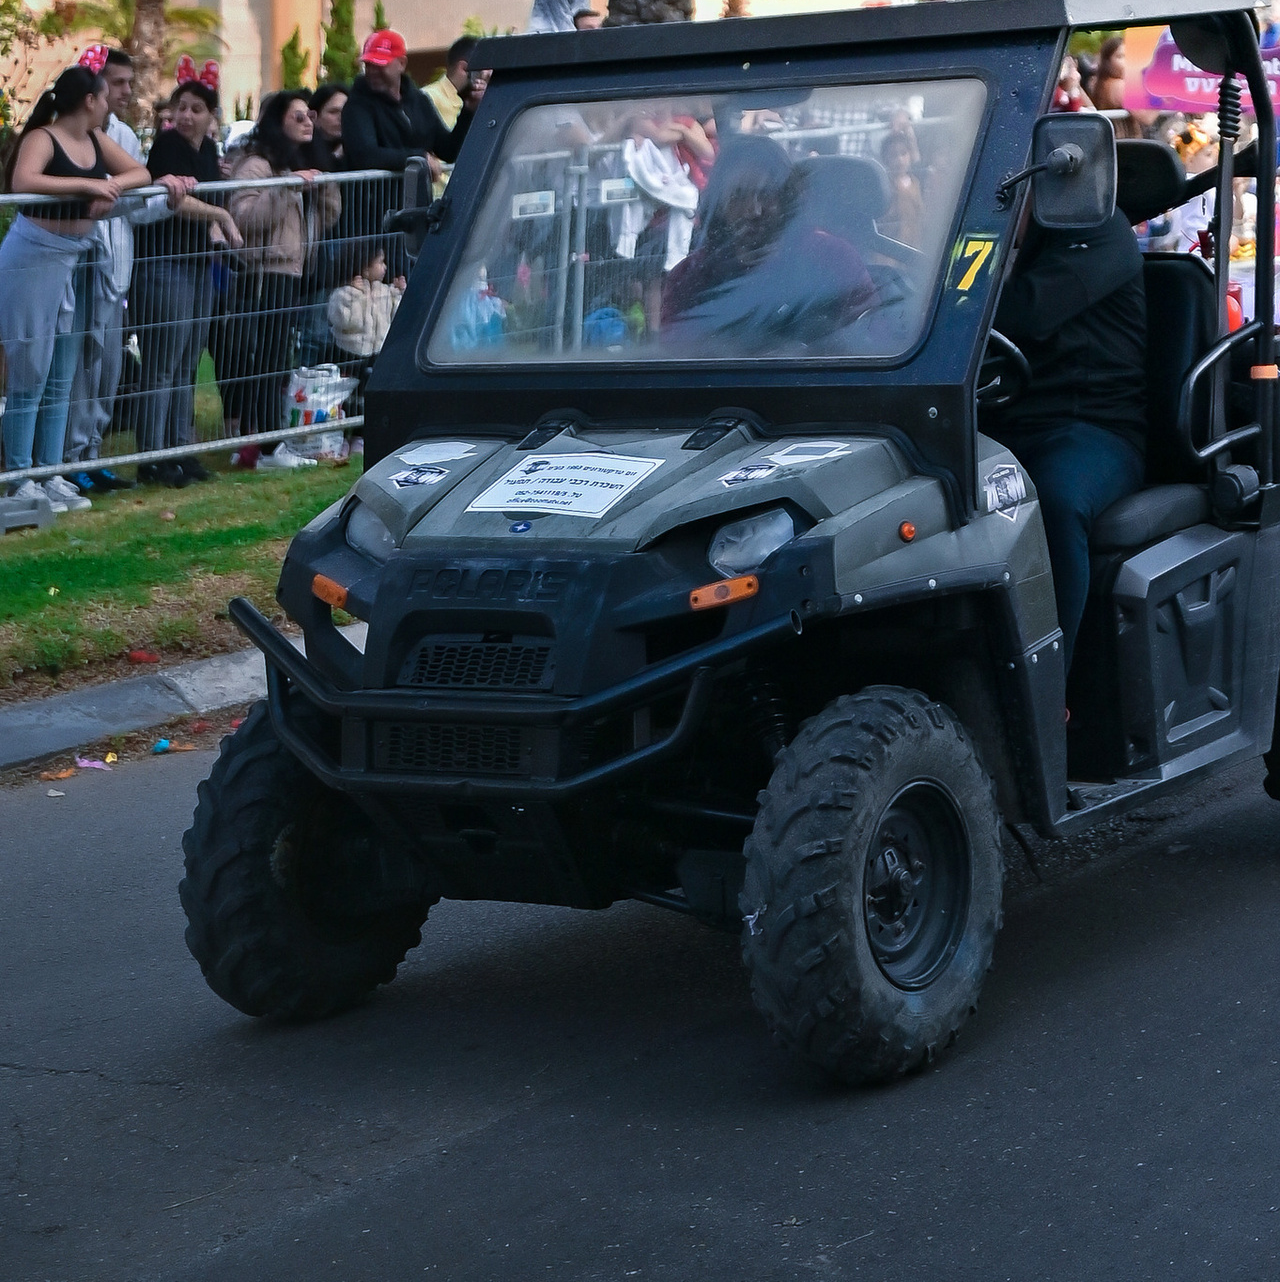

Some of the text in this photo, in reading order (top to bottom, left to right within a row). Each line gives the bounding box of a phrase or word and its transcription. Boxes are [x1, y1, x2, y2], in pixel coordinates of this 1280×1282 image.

[956, 240, 994, 292] 7
[590, 481, 624, 490] השכרת
[407, 567, 569, 602] POLARIS
